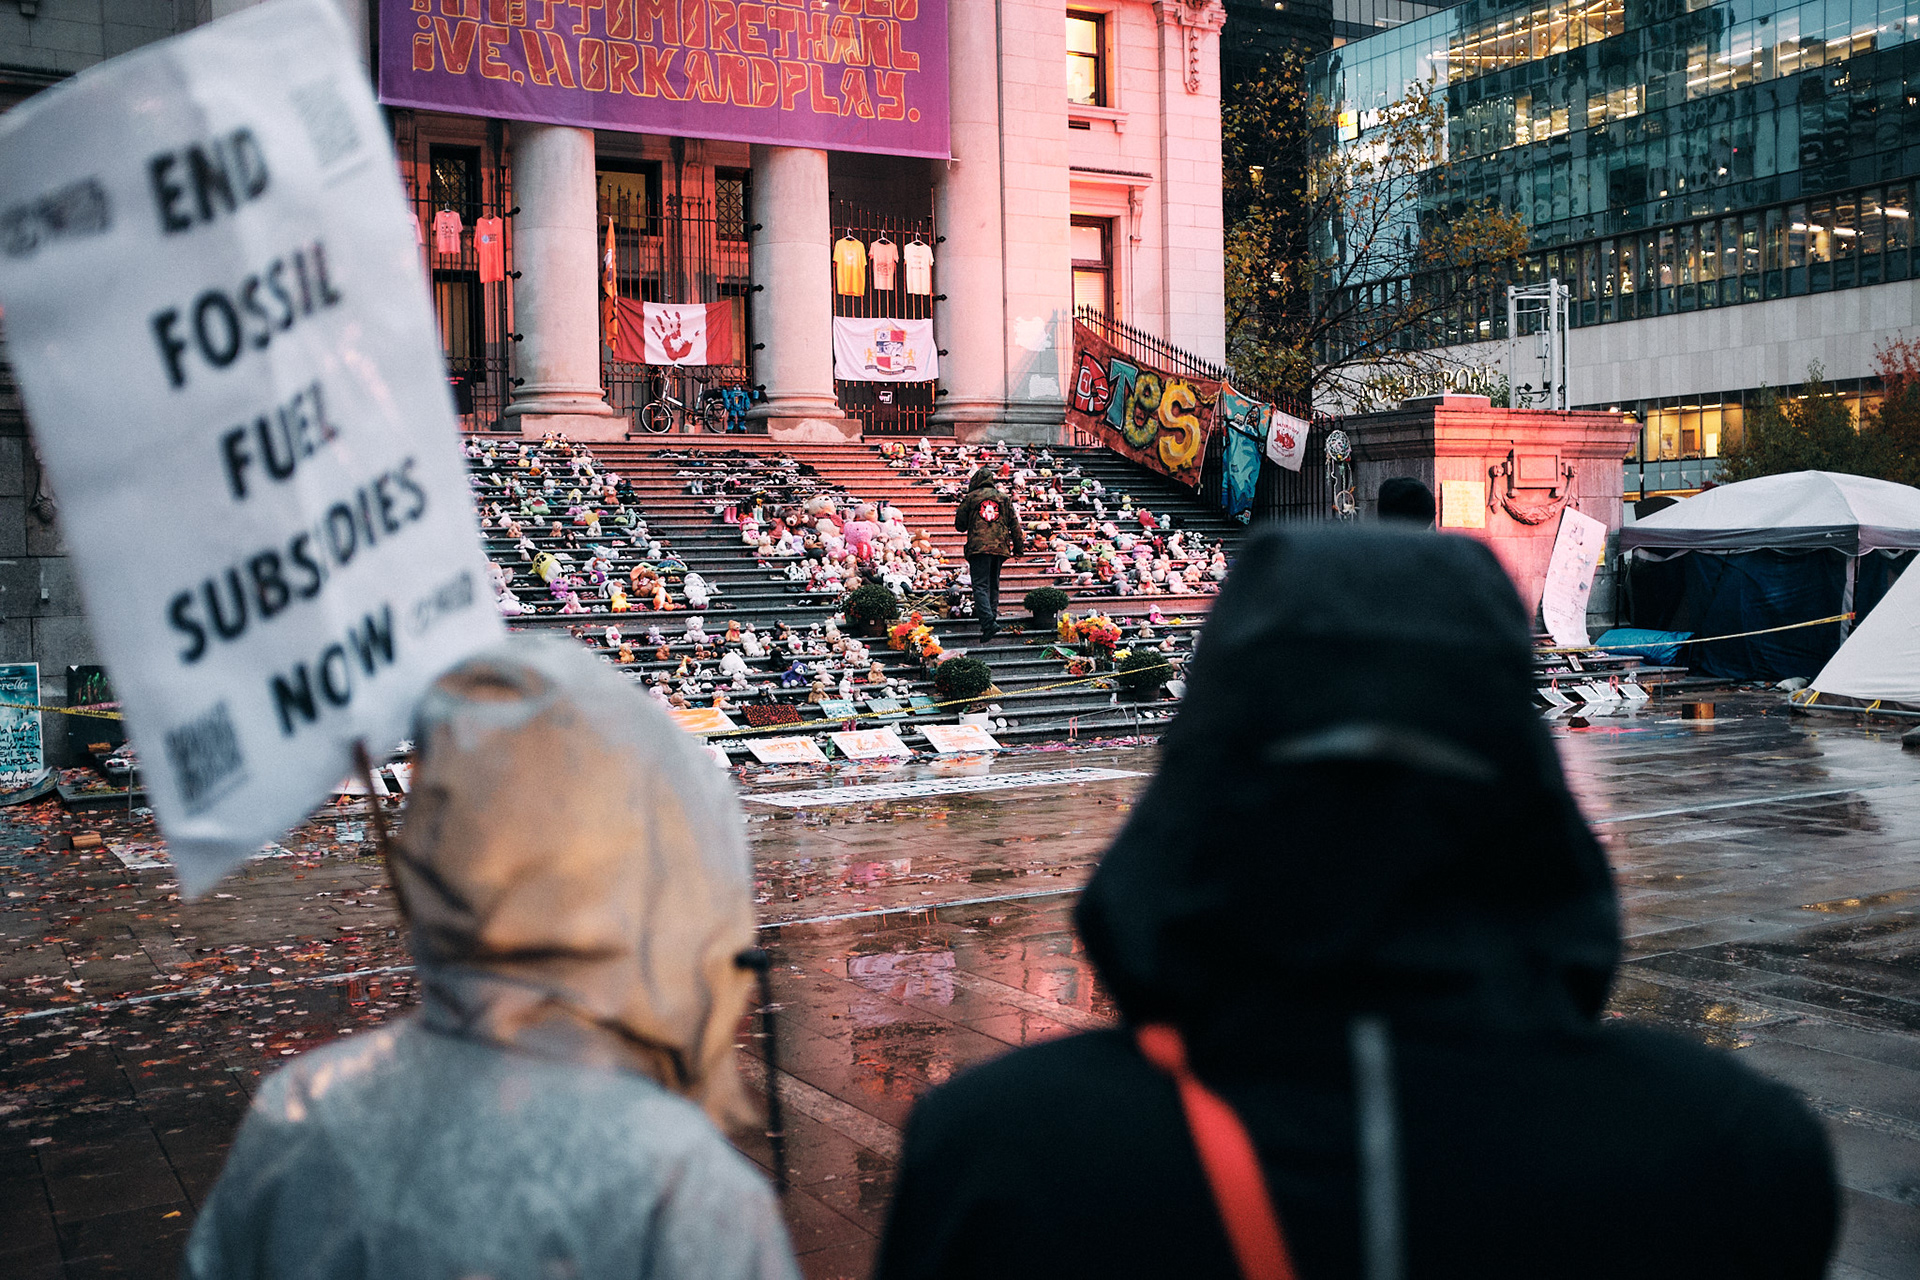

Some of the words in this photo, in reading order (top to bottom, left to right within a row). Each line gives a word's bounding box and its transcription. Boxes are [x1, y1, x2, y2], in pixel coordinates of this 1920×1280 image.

[146, 127, 271, 236] END
[149, 237, 344, 391] FOSSIL
[219, 379, 340, 500] FUEL
[1359, 364, 1490, 403] NODSTROM
[167, 456, 427, 665] SUBSIDIES
[267, 601, 397, 739] NOW
